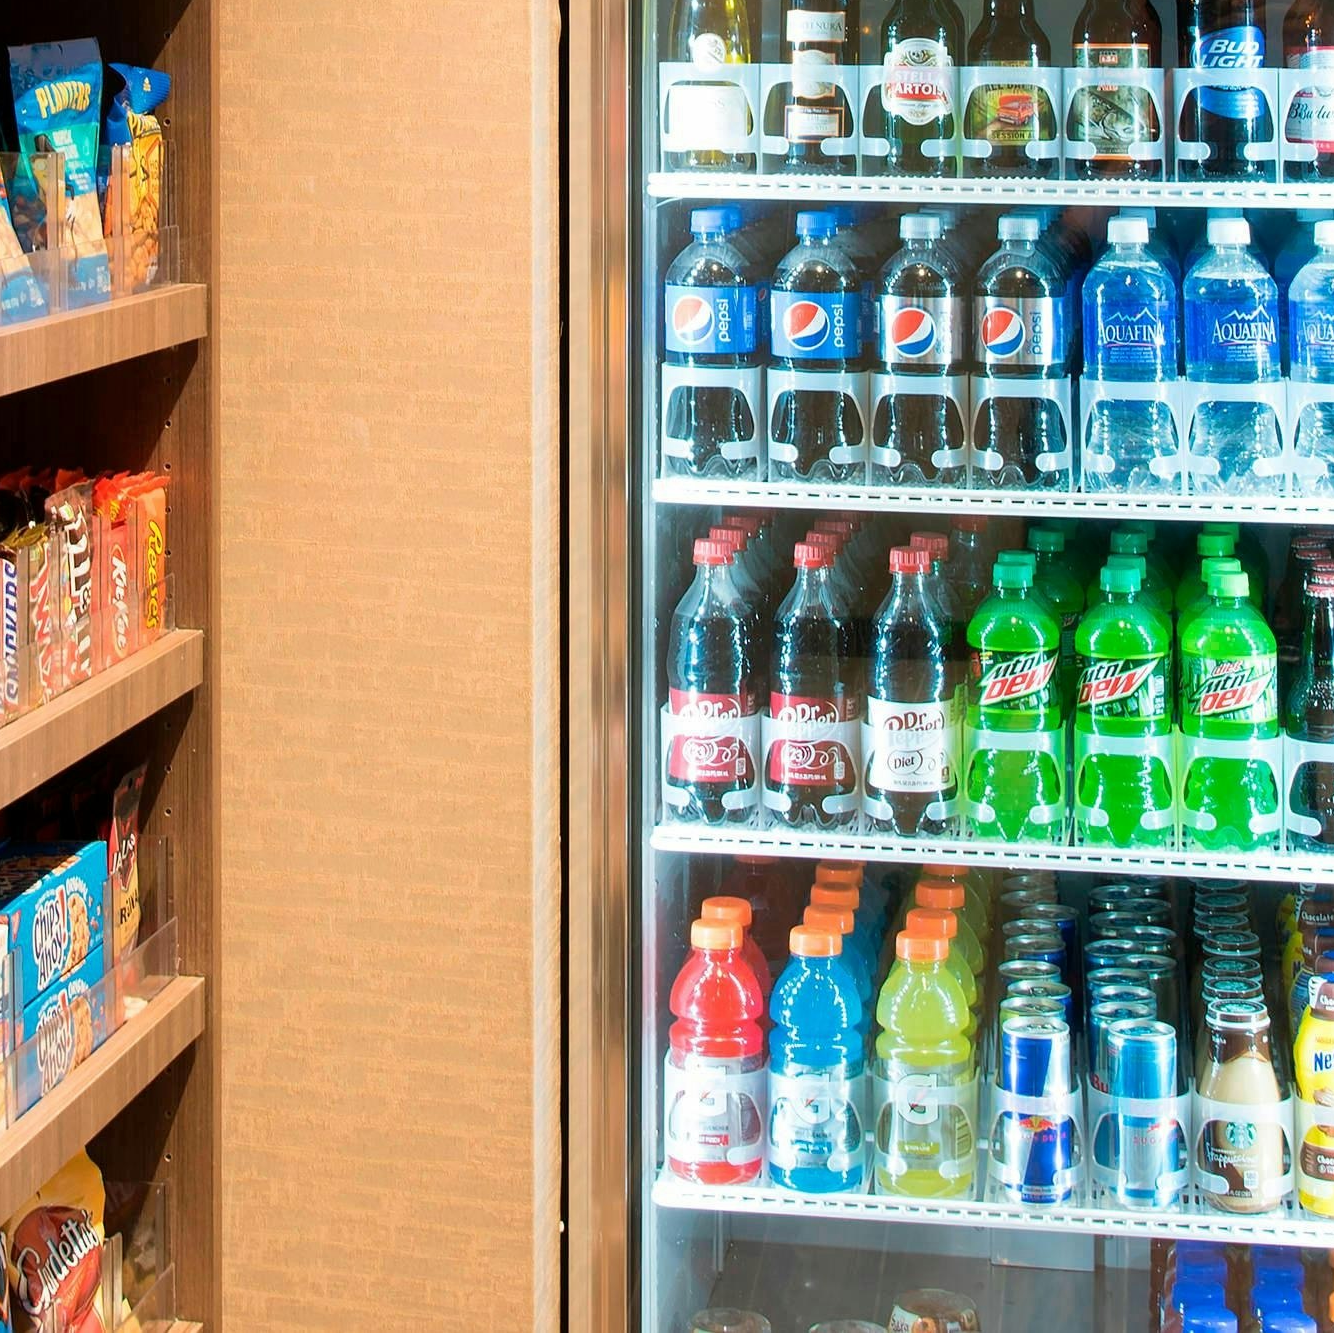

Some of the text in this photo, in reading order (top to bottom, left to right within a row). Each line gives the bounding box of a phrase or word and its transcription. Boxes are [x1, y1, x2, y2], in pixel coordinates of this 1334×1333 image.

[1209, 38, 1260, 55] BUD
[1199, 54, 1264, 68] LIGHT
[35, 80, 92, 119] PLANTERS
[717, 298, 731, 343] pepsi
[831, 303, 844, 348] pepsi
[1030, 311, 1044, 355] pepsi
[1098, 318, 1166, 345] AQUAFINA
[1211, 316, 1277, 344] AQUAFINA
[795, 703, 821, 723] Dr
[903, 711, 927, 730] Dr
[893, 756, 916, 770] Diet
[33, 898, 60, 962] Chips
[1301, 911, 1334, 923] Chocolate
